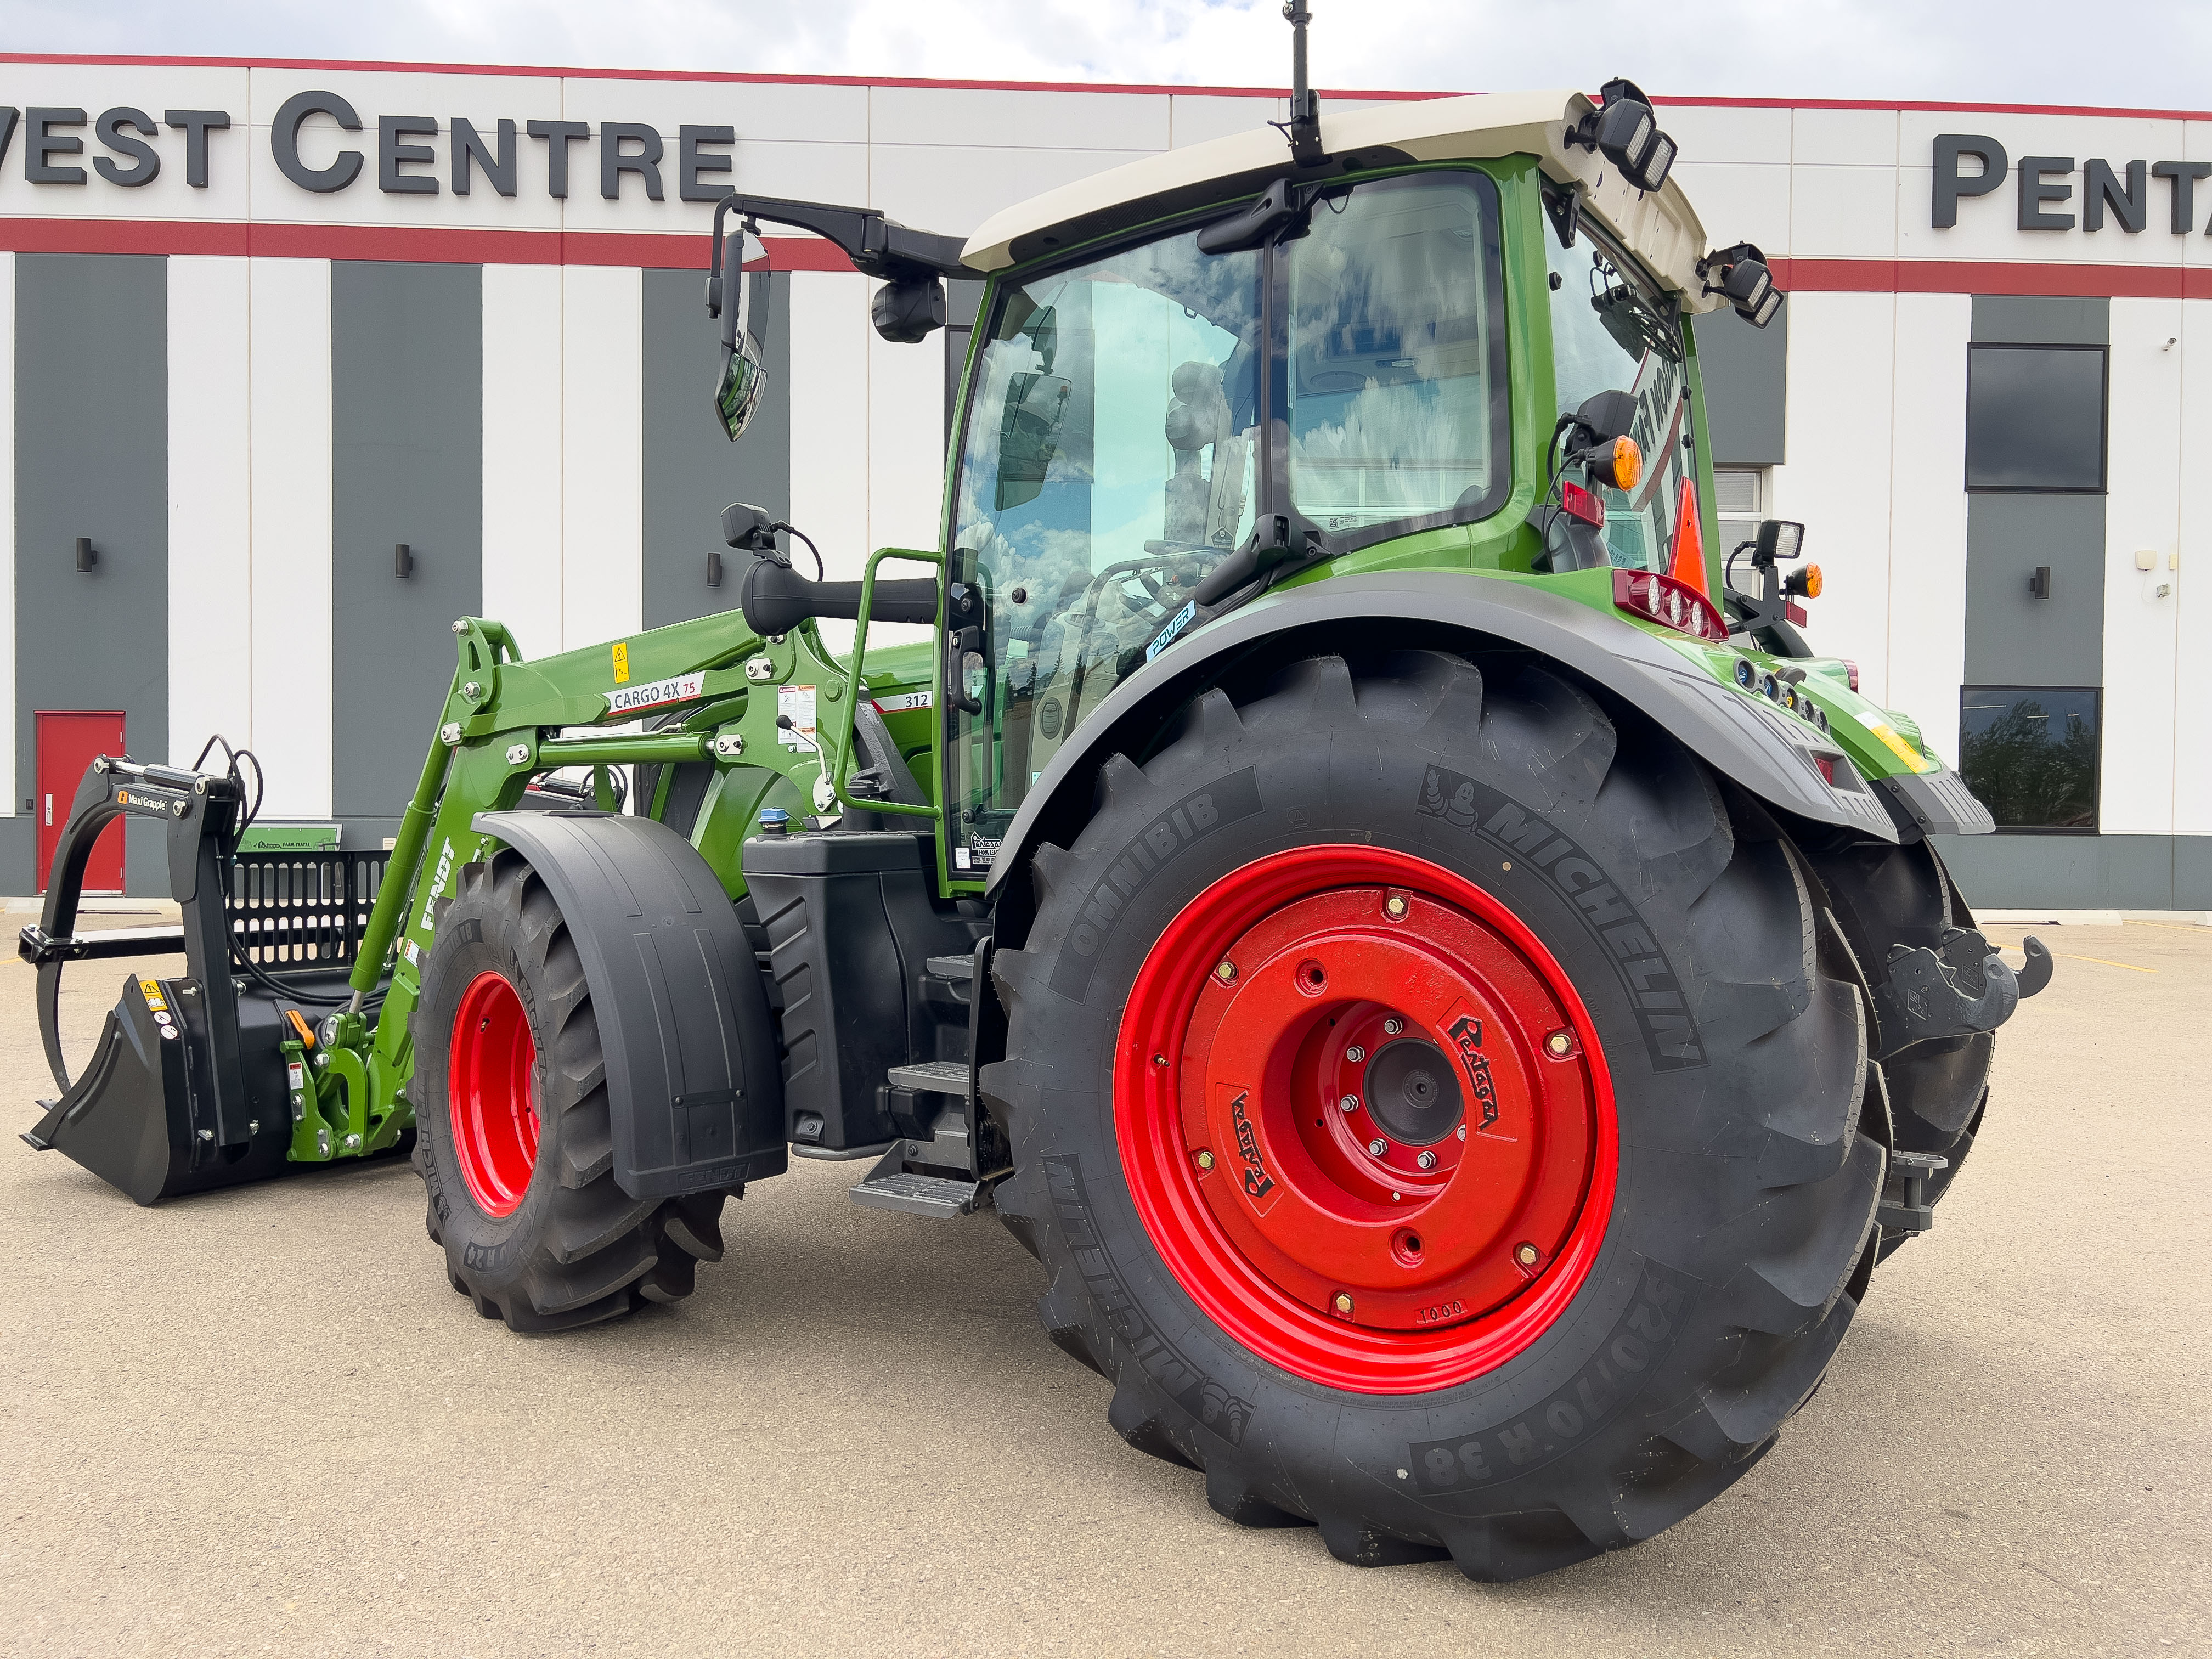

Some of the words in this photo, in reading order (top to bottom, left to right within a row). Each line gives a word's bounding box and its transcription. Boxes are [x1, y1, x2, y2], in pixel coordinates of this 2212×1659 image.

[271, 89, 736, 202] CENTRE
[1932, 133, 2212, 235] PENT
[1152, 607, 1189, 655] POWER
[614, 686, 660, 709] CARGO
[663, 681, 680, 698] 4X
[682, 682, 695, 695] 75
[905, 694, 928, 708] 312
[129, 794, 143, 806] Maxi
[420, 836, 455, 931] FENDT
[1071, 793, 1219, 957] OMNIBIB
[1483, 802, 1702, 1060] MICHELIN
[1045, 1161, 1199, 1401] MICHELIN
[1419, 1301, 1462, 1324] 1000
[1424, 1441, 1493, 1486] 38
[1497, 1421, 1537, 1466] R
